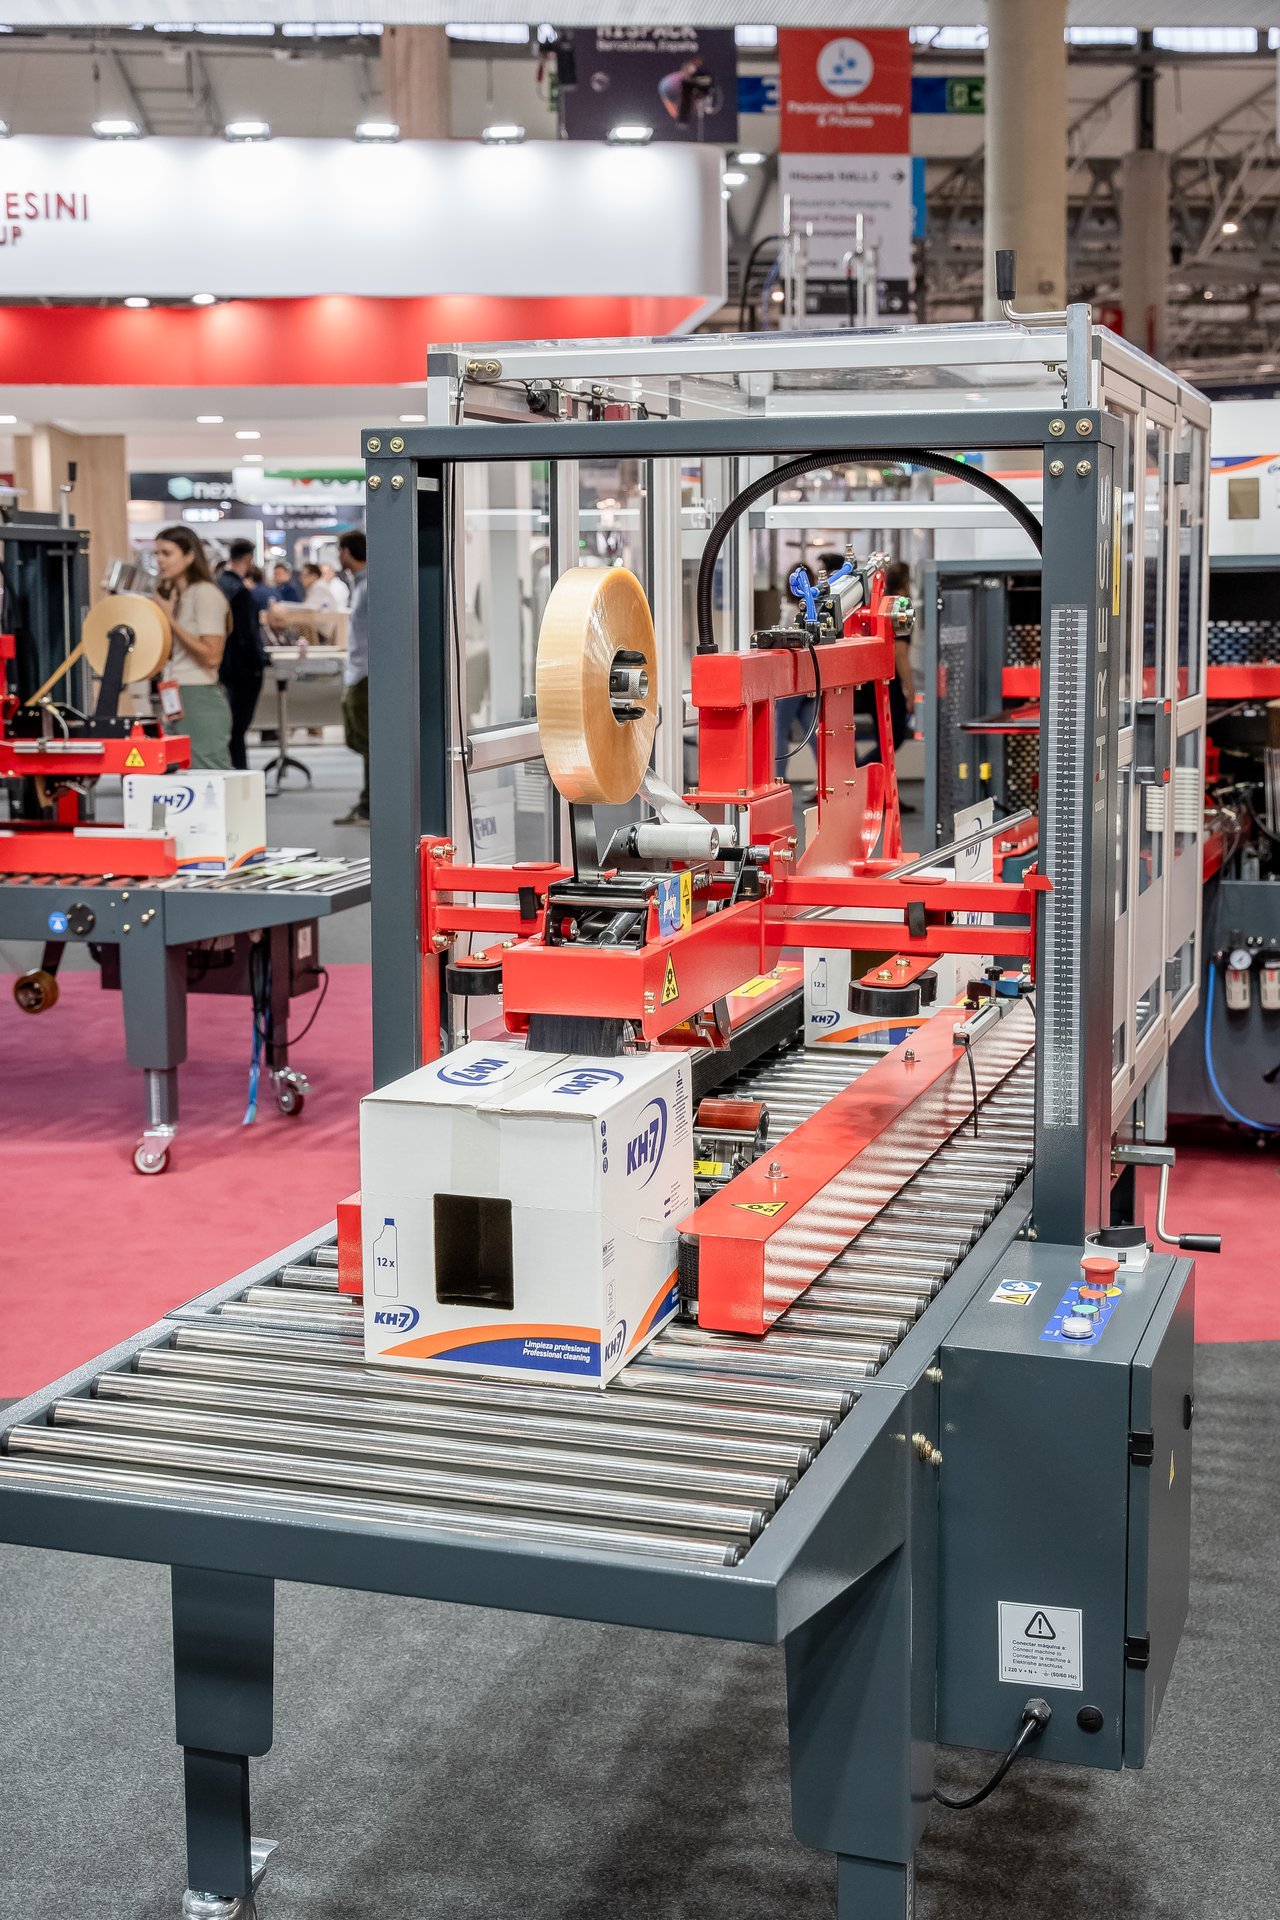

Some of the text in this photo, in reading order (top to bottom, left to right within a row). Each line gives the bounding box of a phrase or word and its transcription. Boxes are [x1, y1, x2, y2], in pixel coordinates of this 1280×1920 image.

[6, 192, 88, 220] ESINI
[377, 1257, 388, 1267] 12
[524, 1340, 590, 1354] Limpieza profesional
[522, 1348, 590, 1364] Professional cleaning
